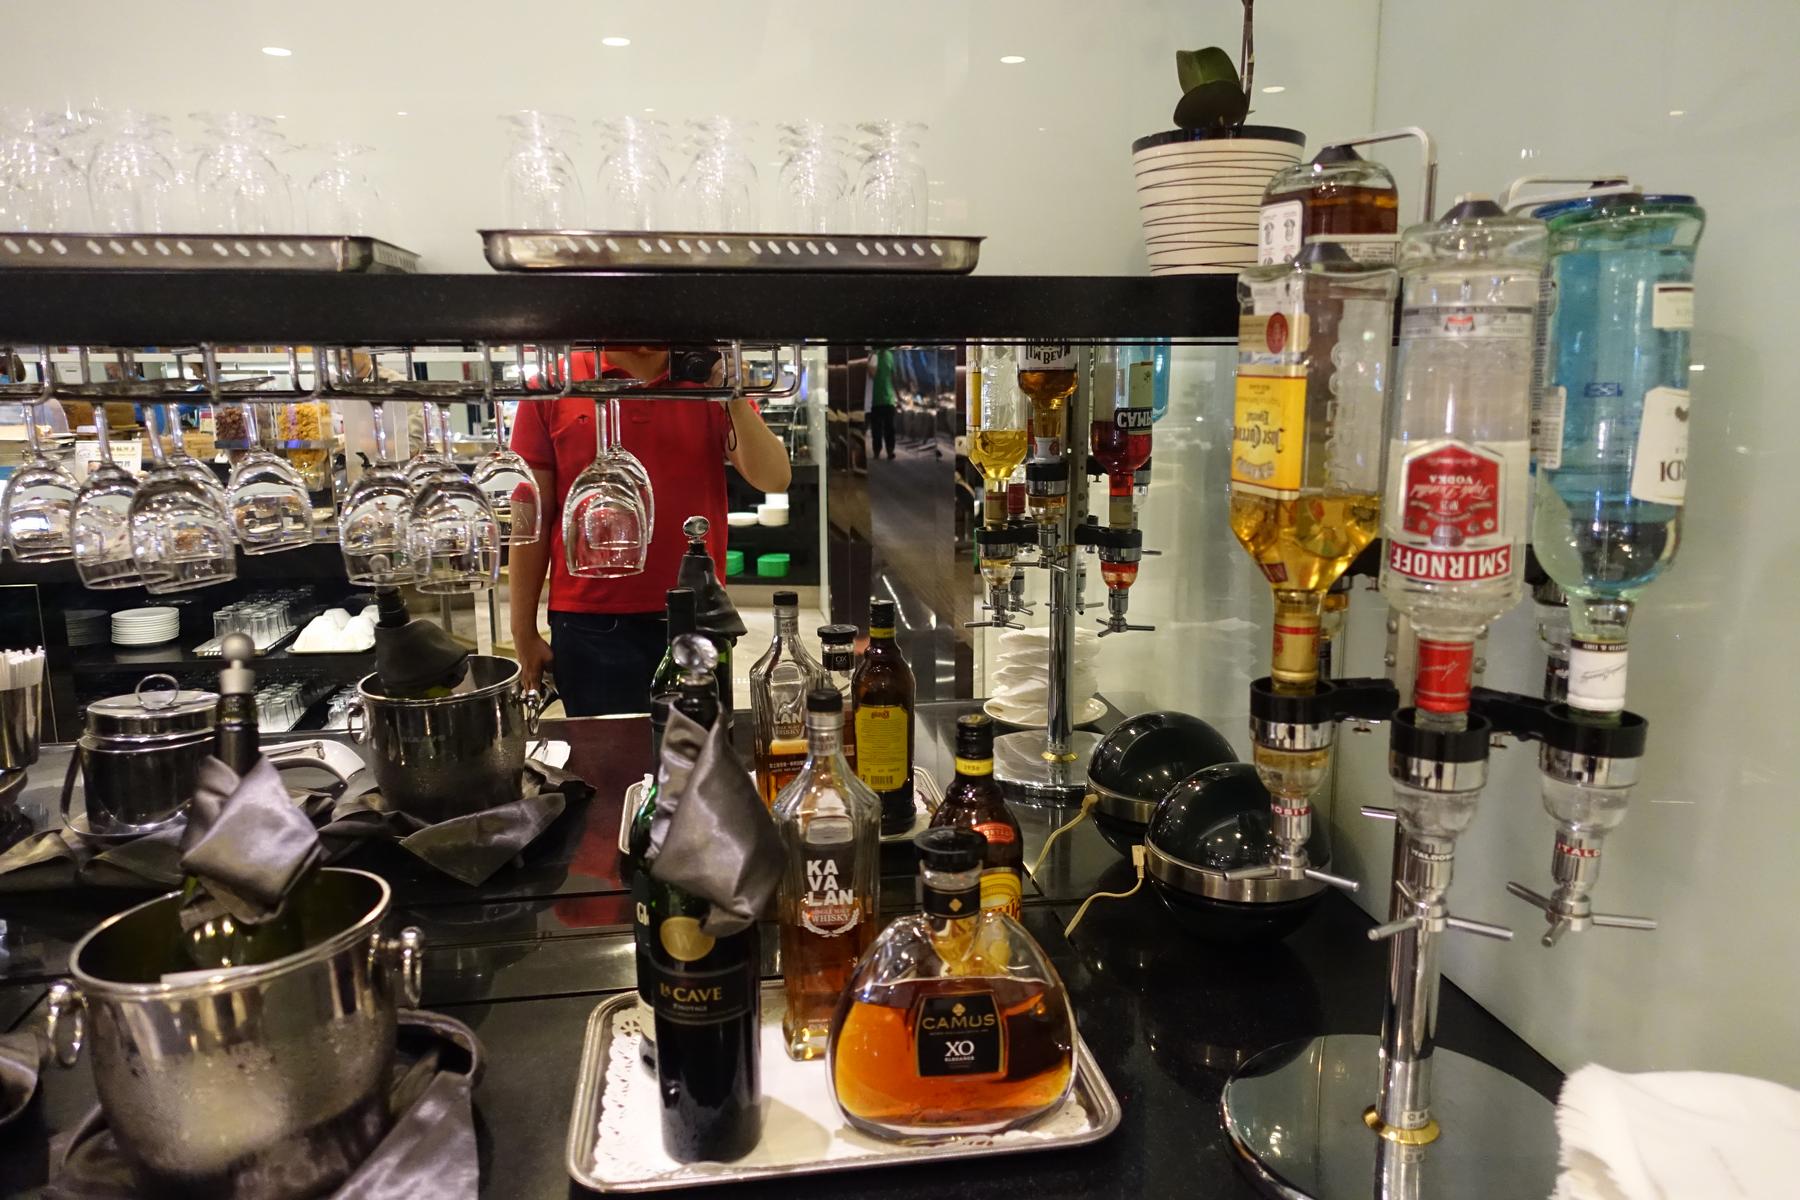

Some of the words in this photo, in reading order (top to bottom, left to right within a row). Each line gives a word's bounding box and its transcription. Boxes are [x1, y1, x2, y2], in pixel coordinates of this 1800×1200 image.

[1429, 475, 1473, 485] VODKA
[1392, 546, 1508, 579] SMIRNOFF
[807, 859, 839, 876] KA
[808, 875, 839, 891] VA
[808, 889, 854, 907] LAN
[672, 986, 722, 1002] CAVE
[922, 1013, 996, 1030] CAMUS
[945, 1040, 975, 1057] XO
